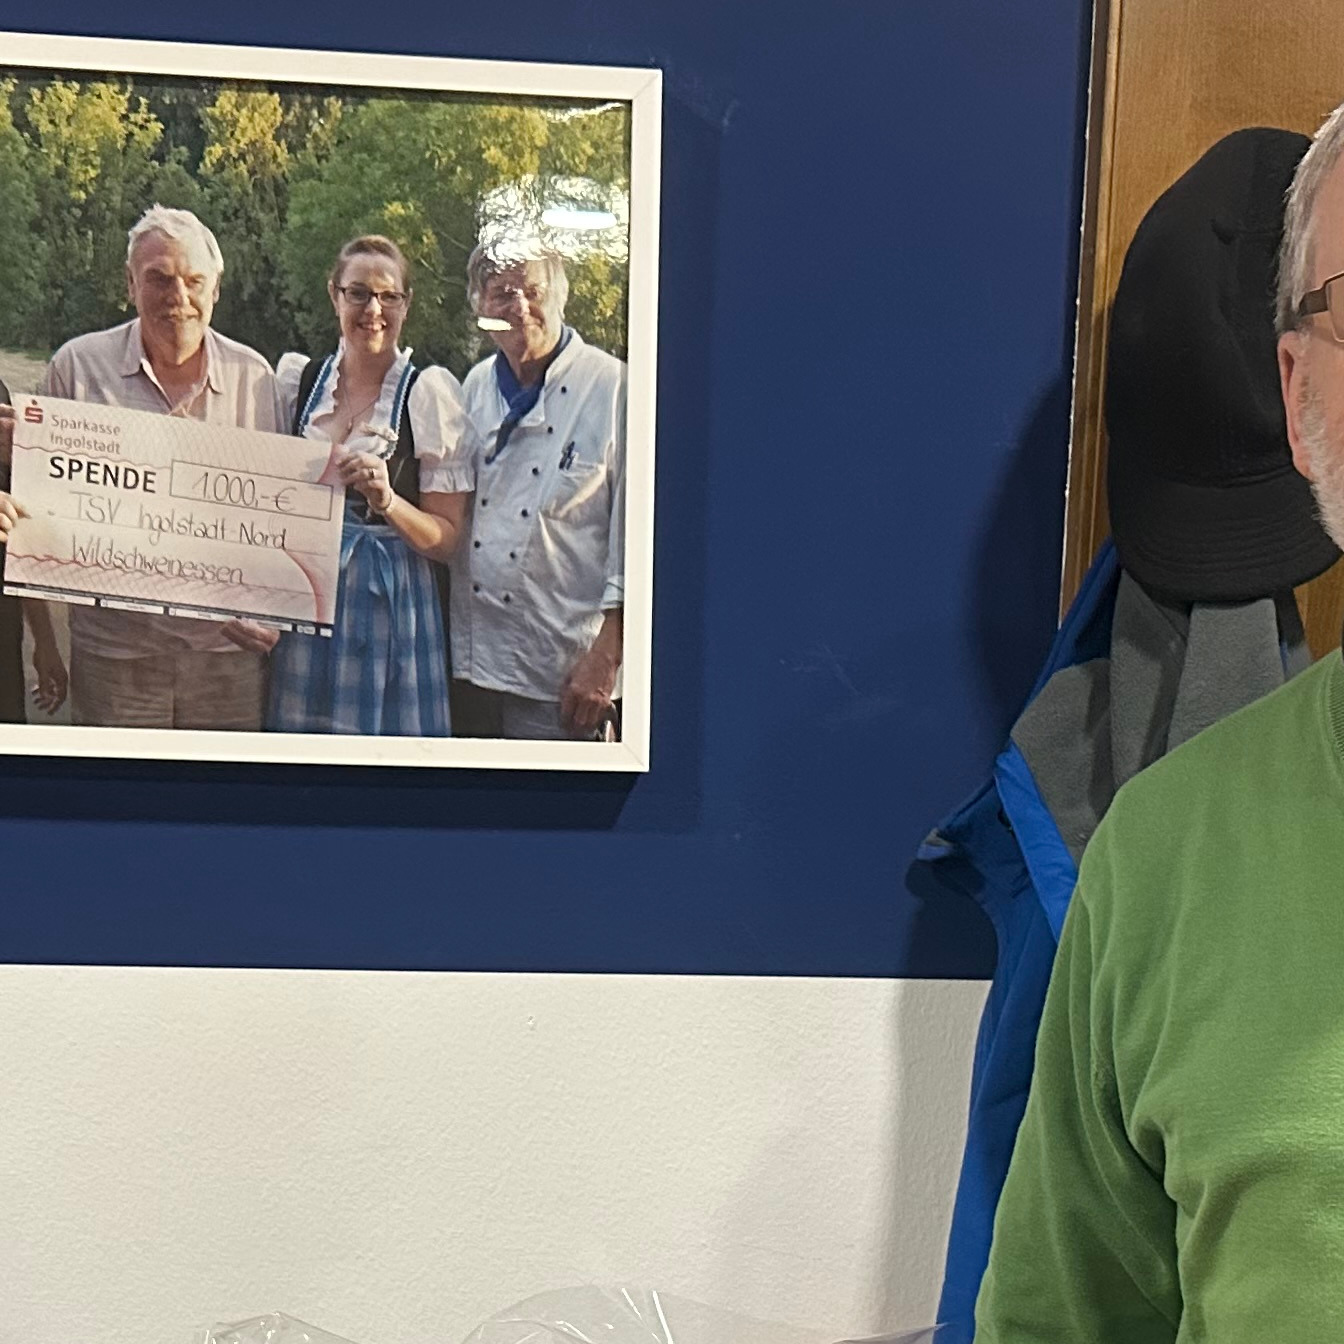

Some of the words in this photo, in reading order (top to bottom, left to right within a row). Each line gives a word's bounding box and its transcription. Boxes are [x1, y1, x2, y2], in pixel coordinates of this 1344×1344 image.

[51, 414, 121, 436] Sparkasse
[50, 432, 121, 455] Ingolstadt
[49, 456, 157, 494] SPENDE
[69, 490, 122, 525] TSV
